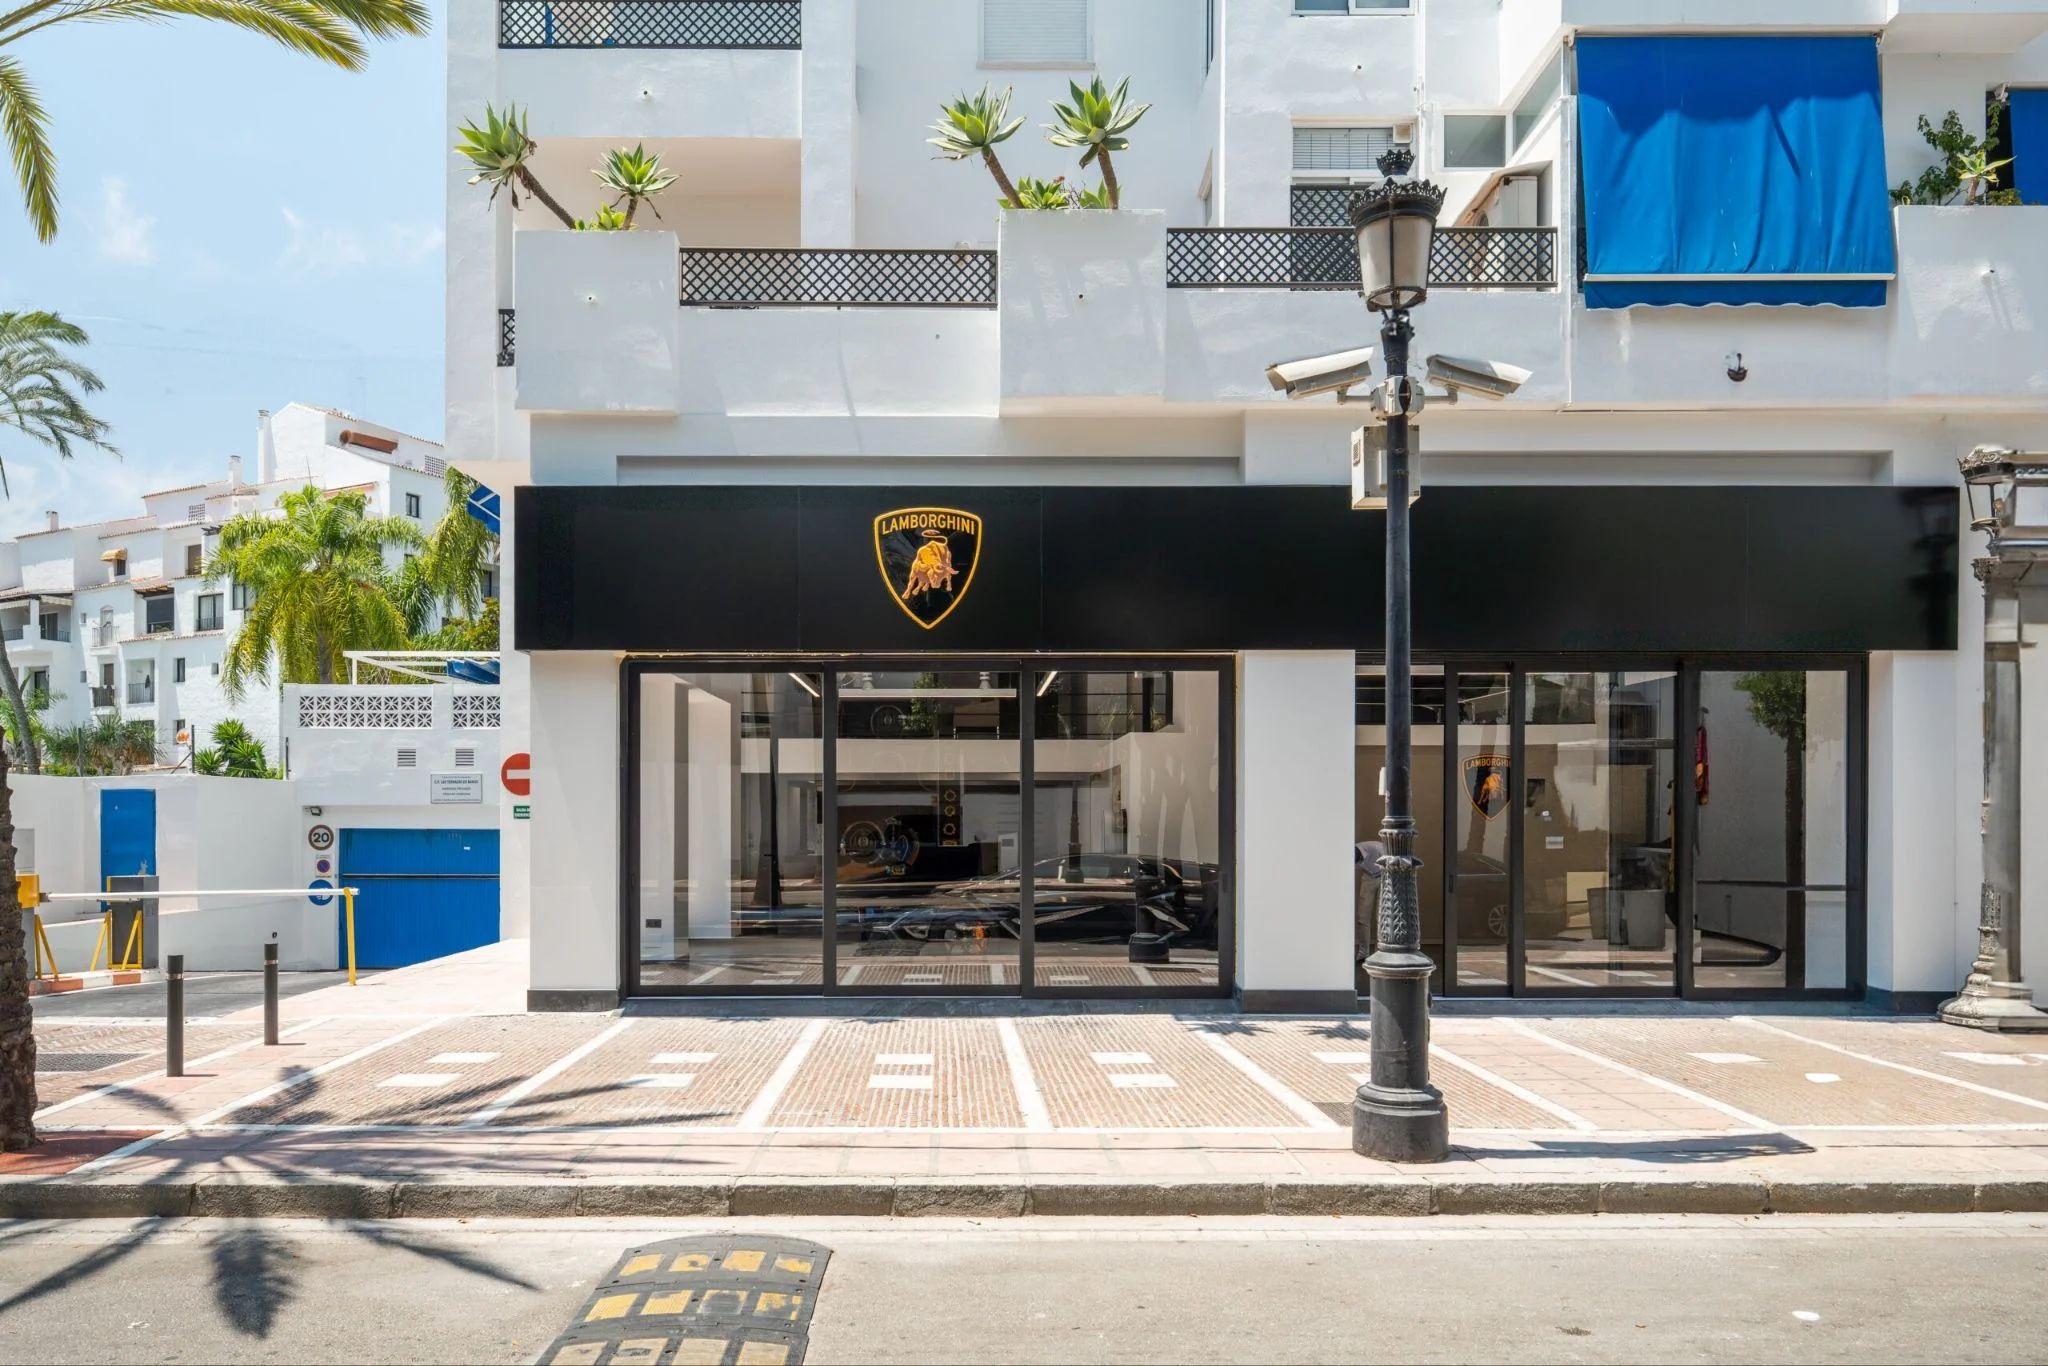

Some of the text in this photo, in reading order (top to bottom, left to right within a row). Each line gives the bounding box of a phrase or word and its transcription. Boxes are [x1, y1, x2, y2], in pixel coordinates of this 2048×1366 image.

[882, 514, 975, 535] LAMBORGHINI
[1465, 758, 1510, 770] LAMBORGHI
[313, 832, 329, 842] 20
